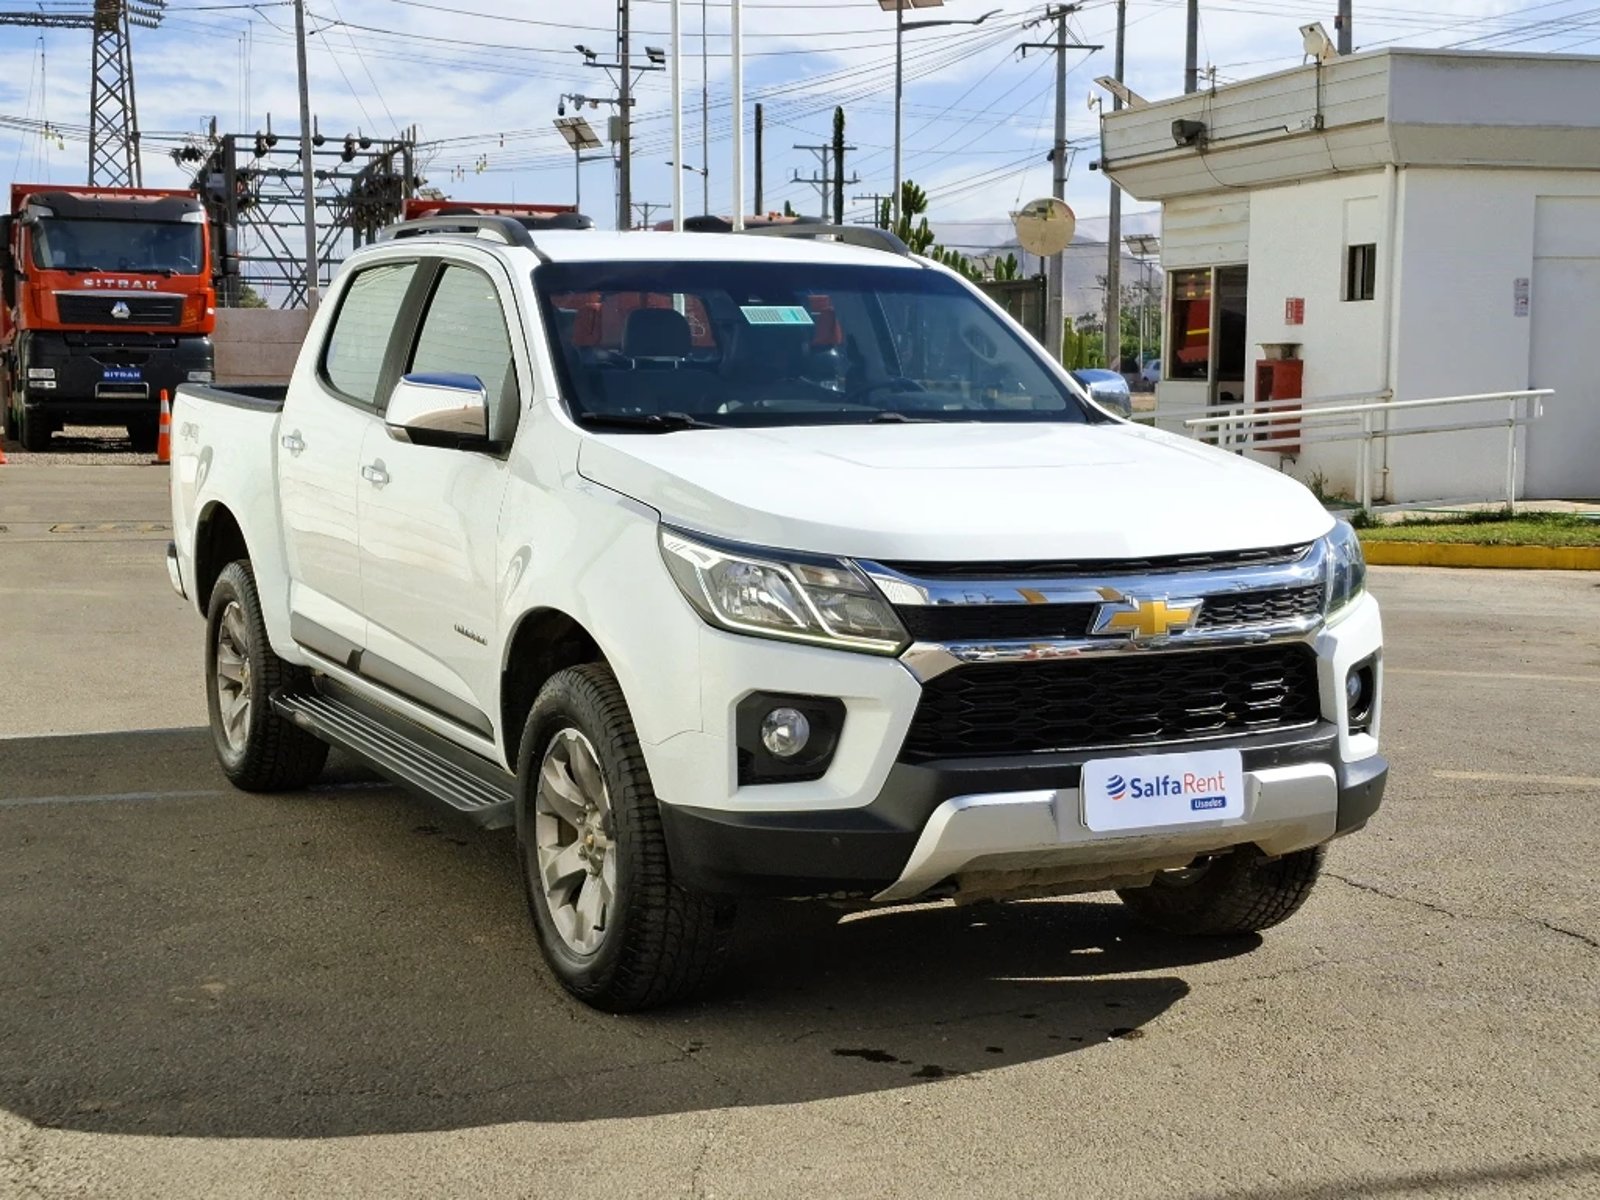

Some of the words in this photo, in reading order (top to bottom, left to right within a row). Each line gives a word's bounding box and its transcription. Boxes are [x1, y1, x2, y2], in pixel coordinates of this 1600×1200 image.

[83, 279, 158, 290] SITRAK
[1130, 770, 1226, 798] SalfaRent
[1194, 798, 1223, 809] Usados
